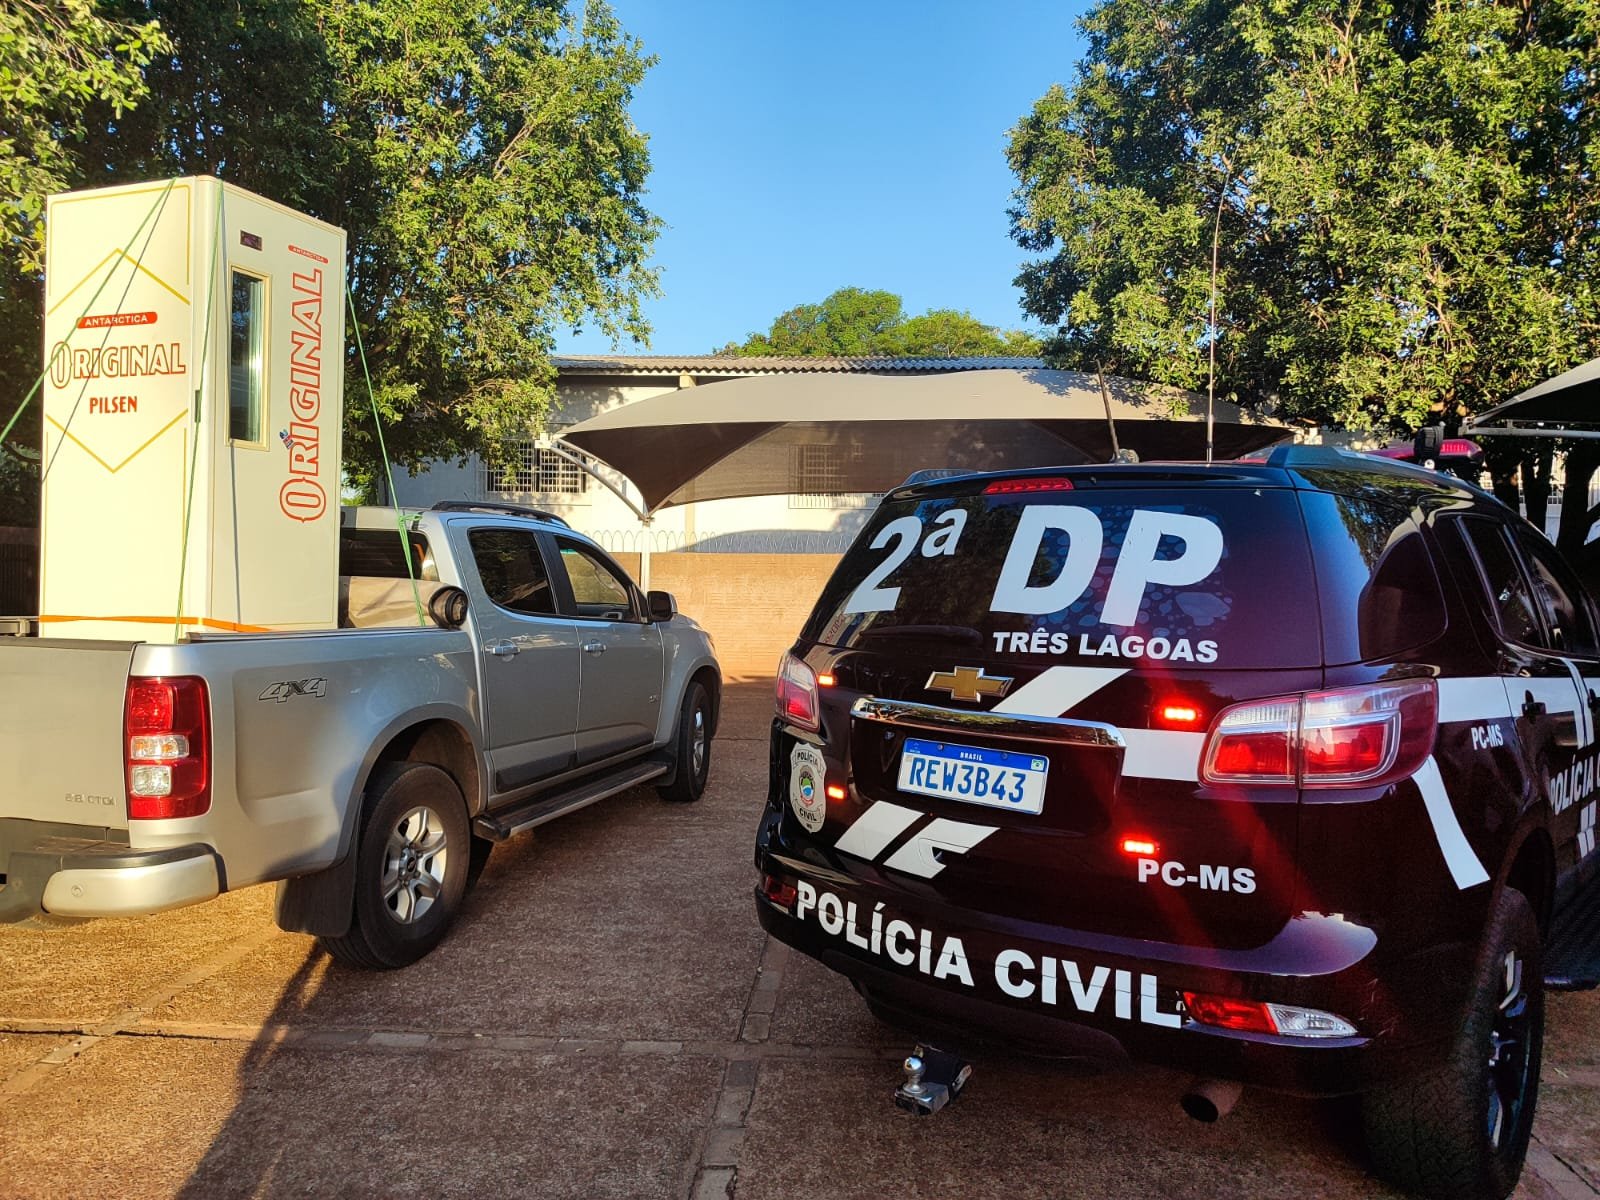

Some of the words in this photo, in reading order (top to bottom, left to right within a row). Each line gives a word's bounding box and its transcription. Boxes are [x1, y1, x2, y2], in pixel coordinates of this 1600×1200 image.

[84, 314, 149, 326] ANTARCTICA
[50, 341, 187, 390] ORIGINAL
[89, 396, 138, 414] PILSEN
[280, 268, 327, 523] ORIGINAL
[989, 504, 1224, 627] DP
[992, 628, 1069, 655] TRÊS
[1078, 633, 1219, 663] LAGOAS
[1470, 724, 1504, 750] PC-MS
[960, 751, 983, 761] BRASIL
[909, 757, 1026, 803] REW3B43
[1550, 753, 1594, 816] POLÍCIA
[800, 807, 818, 821] CIVIL
[1137, 858, 1257, 895] PC-MS
[796, 880, 975, 987] POLÍCIA
[995, 949, 1183, 1029] CIVIL
